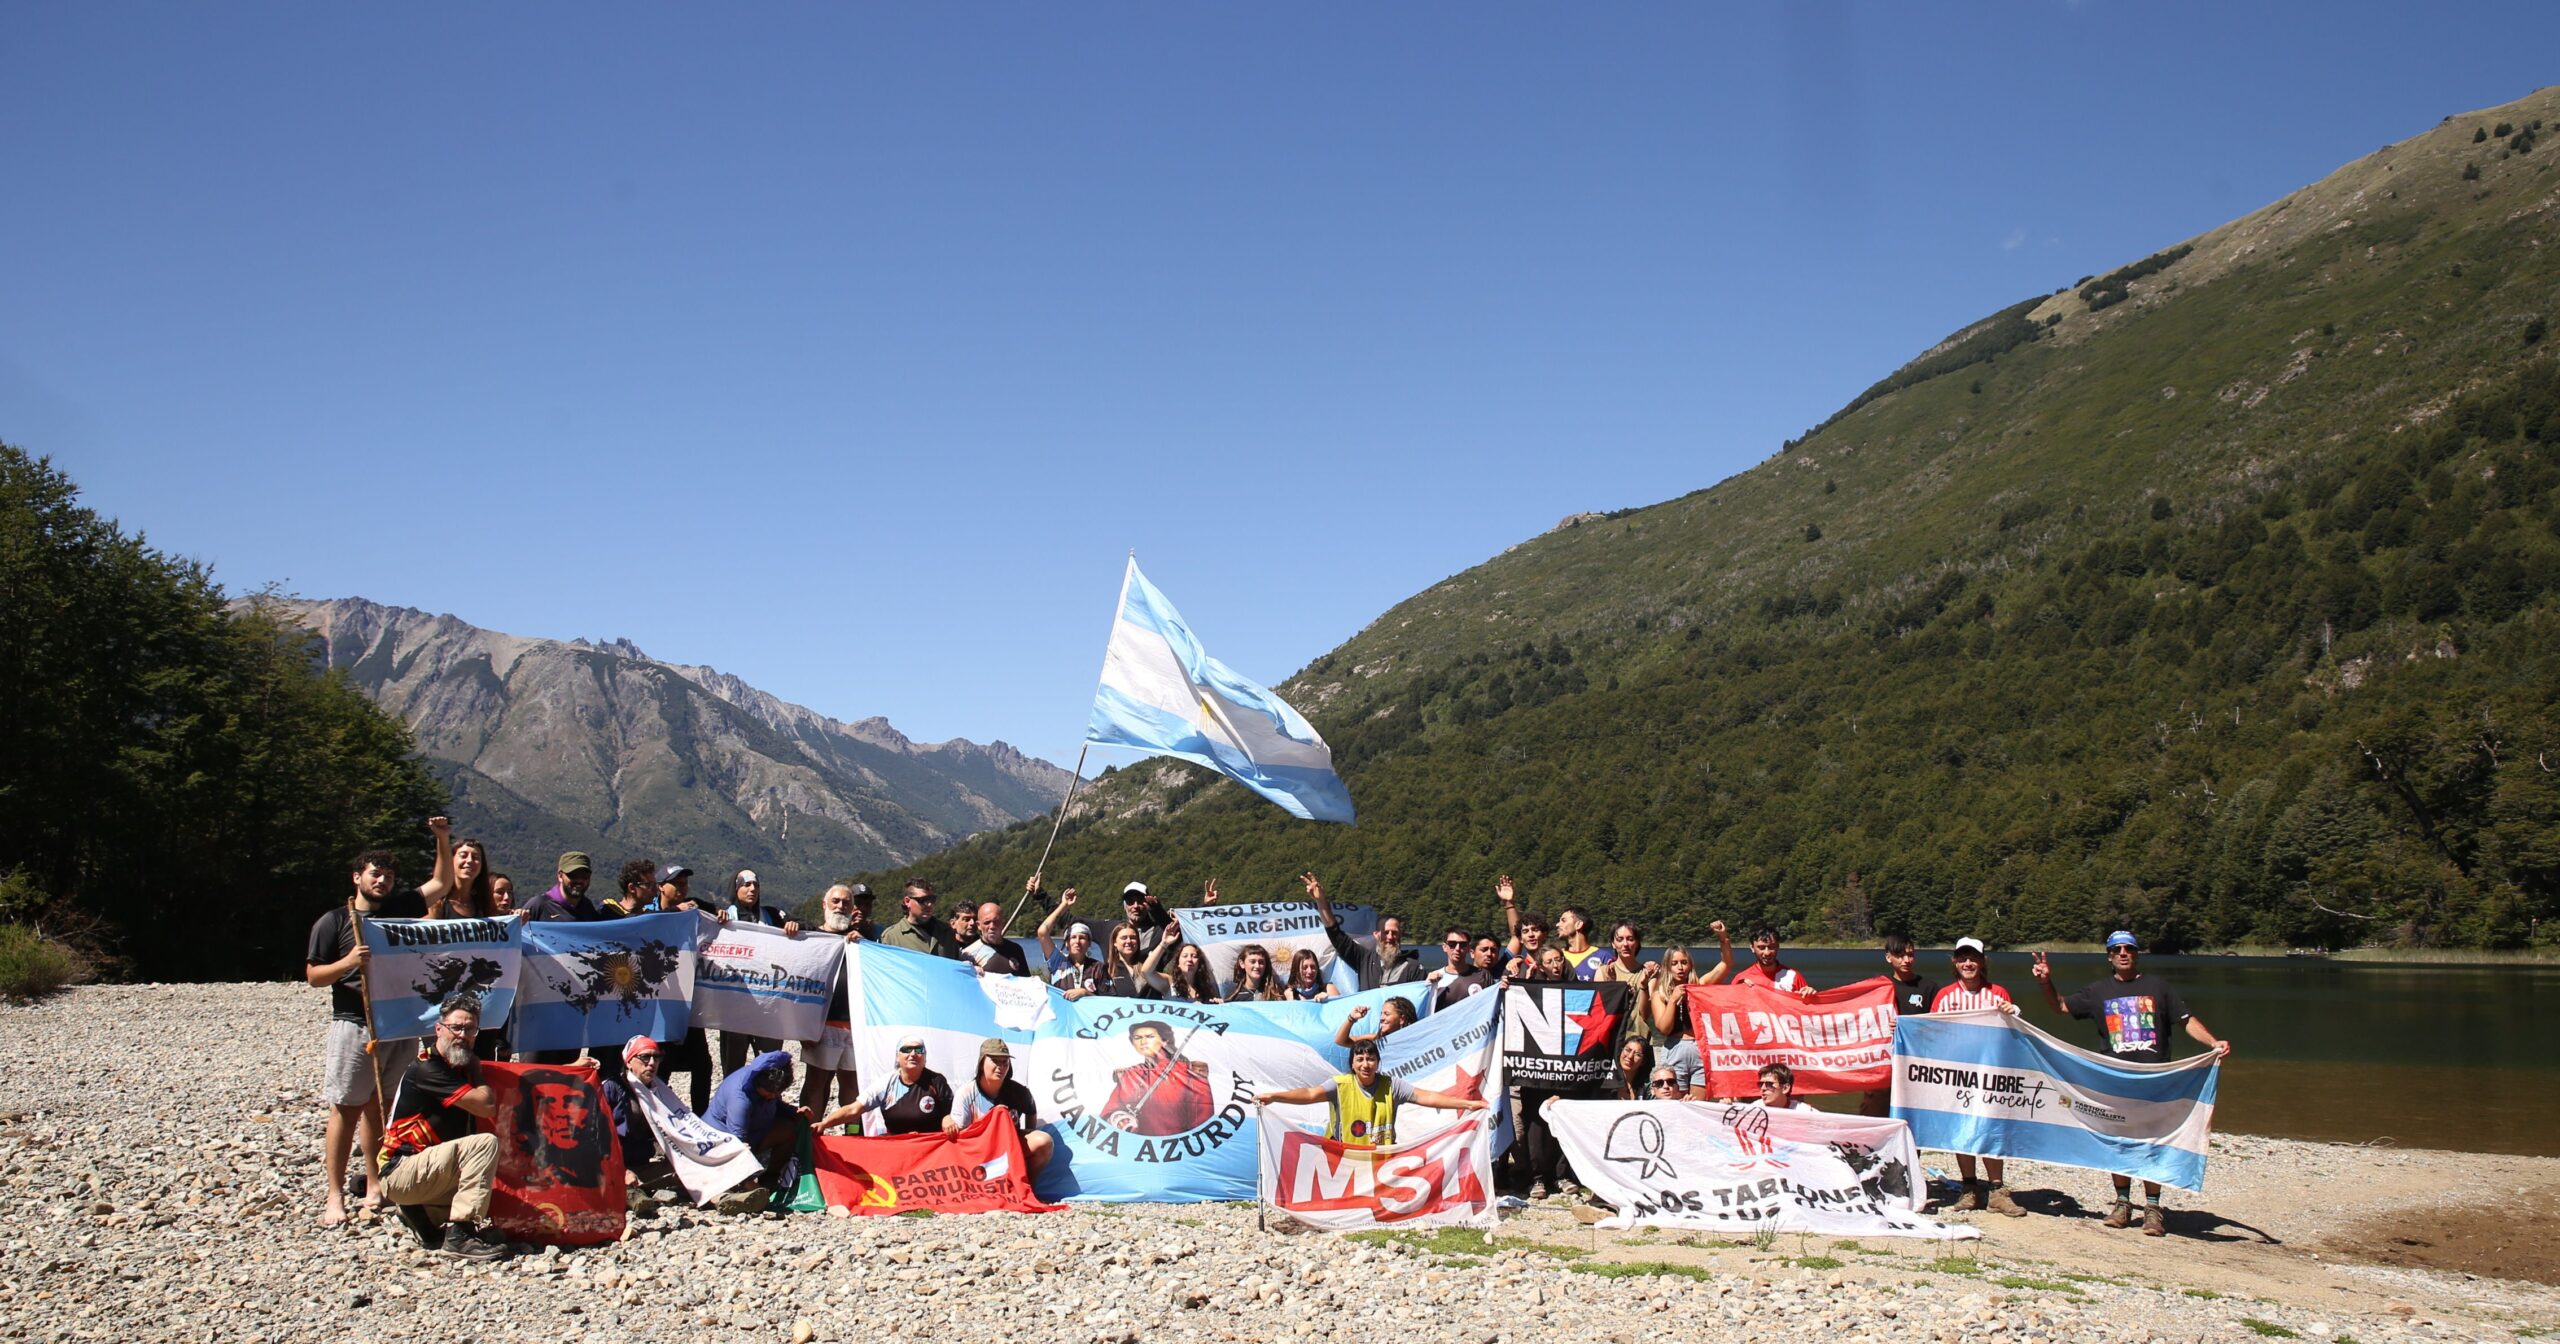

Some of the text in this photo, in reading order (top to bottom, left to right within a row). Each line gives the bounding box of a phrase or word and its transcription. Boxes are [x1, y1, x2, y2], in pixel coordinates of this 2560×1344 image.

[1191, 902, 1359, 921] LAGO ESCONDO
[382, 921, 509, 946] VOLVEREMOS
[1207, 923, 1228, 936] ES
[1076, 1003, 1230, 1041] COLUMNA
[1701, 1012, 1745, 1047] LA
[1503, 1055, 1618, 1073] NUESTRAMÉRCA
[1716, 1049, 1892, 1068] MOVIMIENTO POPULA
[1511, 1069, 1614, 1082] MOVIMIENTO POPLAR
[1908, 1063, 2026, 1094] CRISTINA LIBRE
[1956, 1089, 1974, 1108] es
[1983, 1080, 2056, 1118] inocente
[2075, 1100, 2106, 1113] PARTIDO
[1051, 1068, 1255, 1163] JUANA AZURDUY
[2075, 1105, 2126, 1120] JUSTICIALISTA
[891, 1165, 988, 1189] PARTIDO
[1291, 1128, 1479, 1214] MST
[1712, 1178, 1862, 1207] TABLONE
